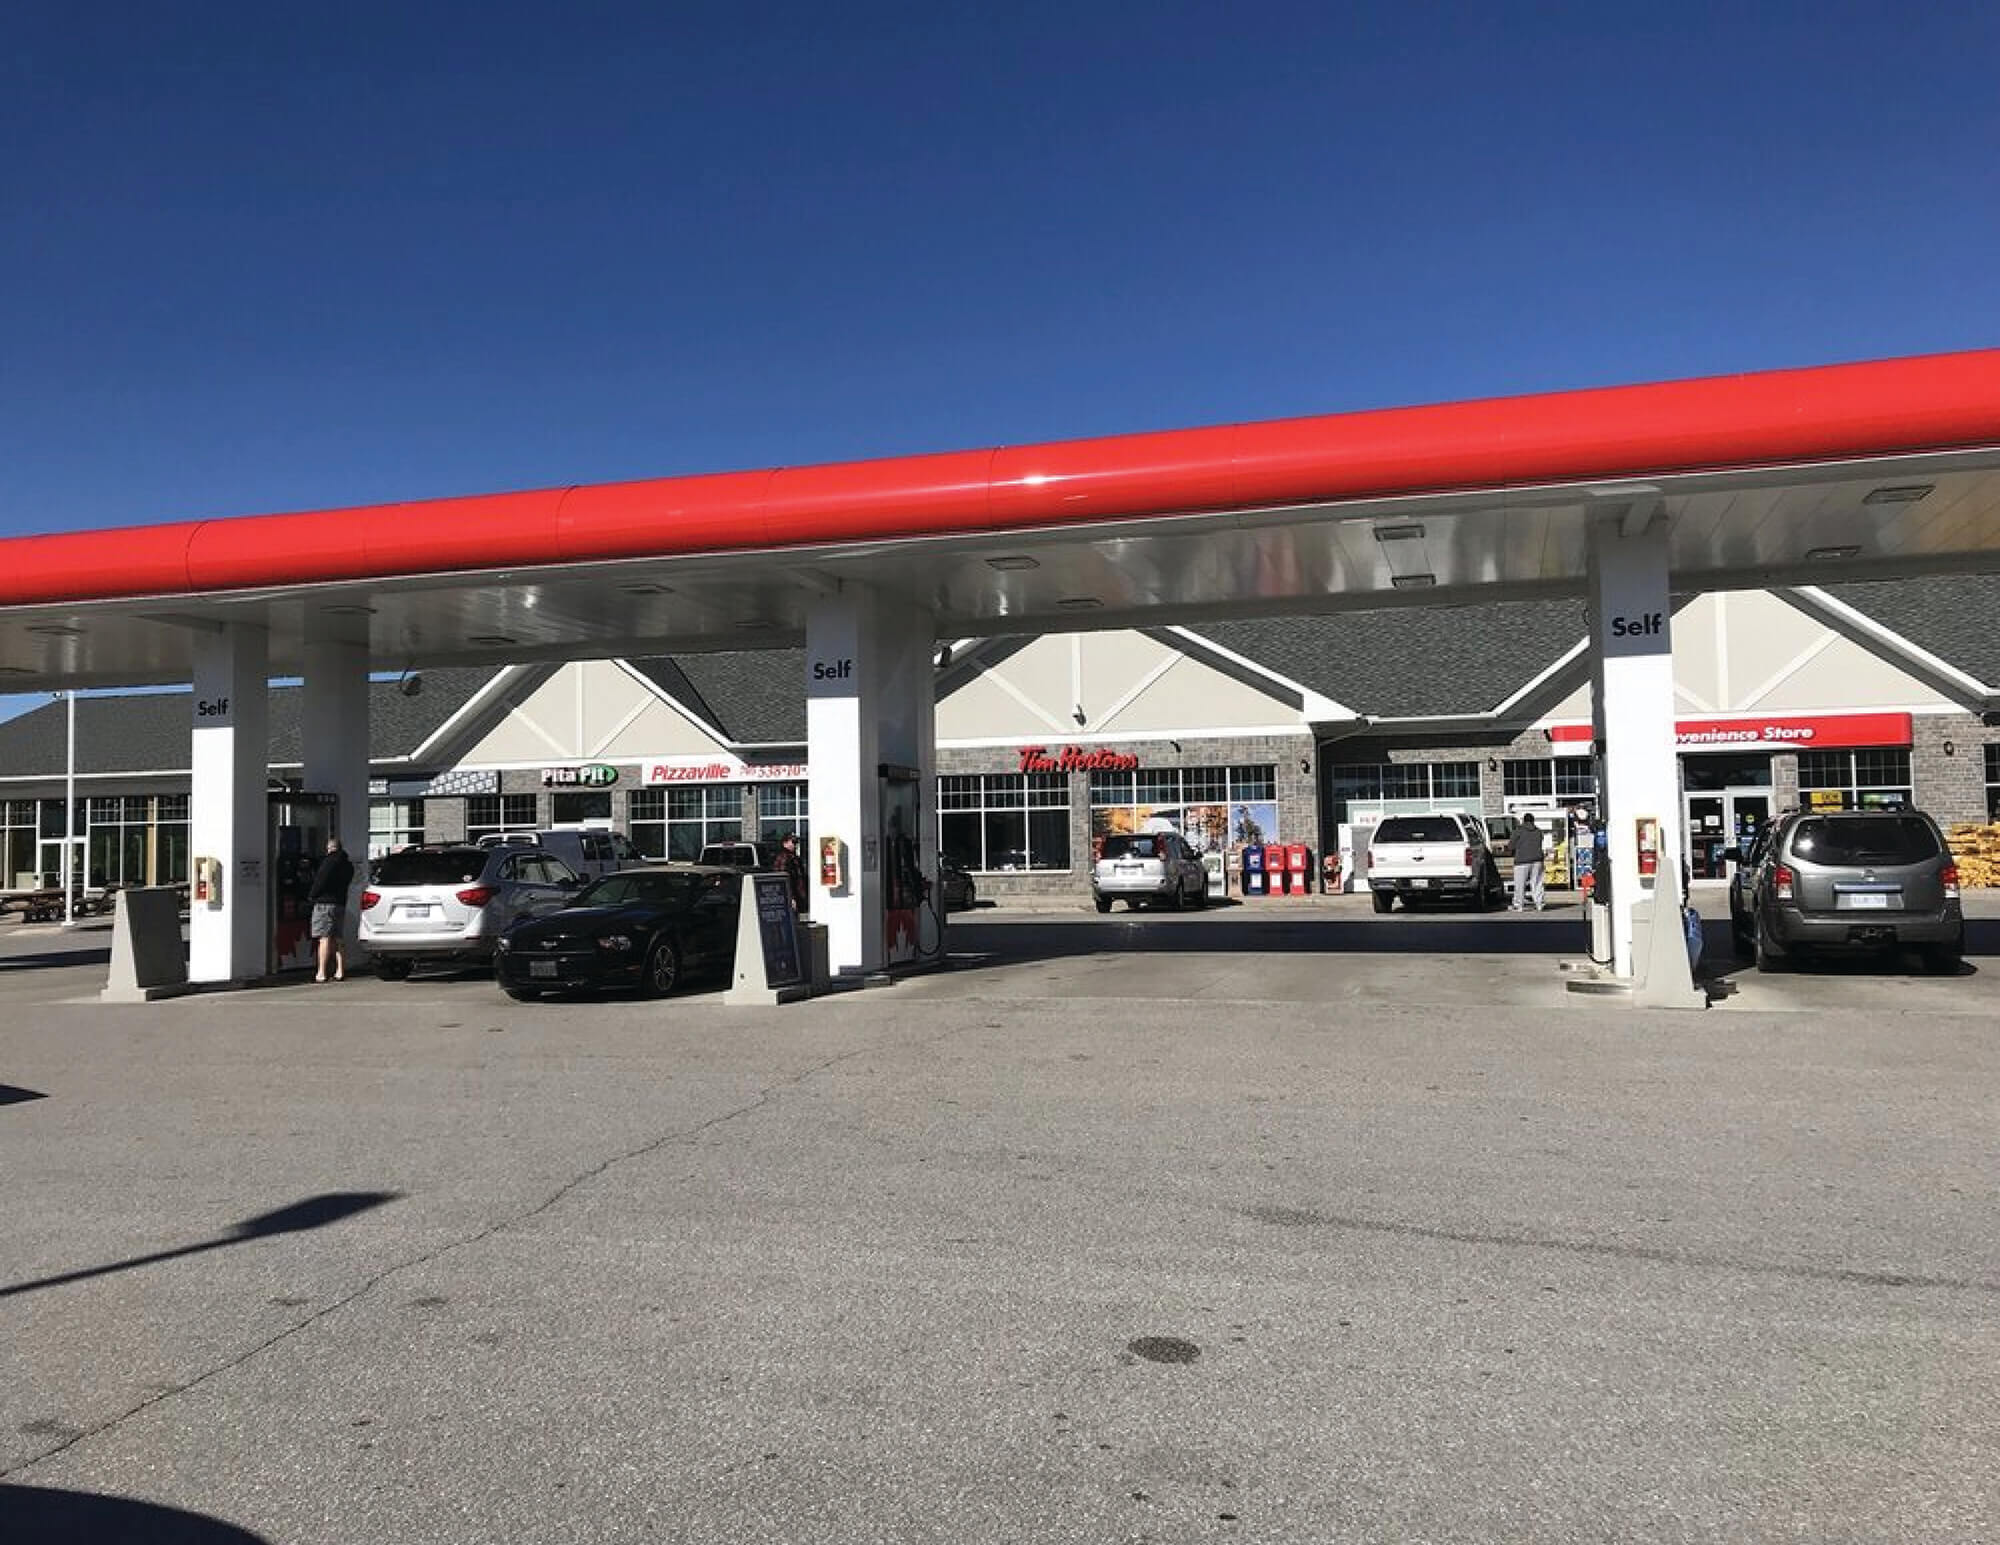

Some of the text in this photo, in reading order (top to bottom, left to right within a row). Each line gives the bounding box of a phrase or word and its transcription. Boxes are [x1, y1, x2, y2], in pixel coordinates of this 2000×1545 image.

[1611, 613, 1662, 636] Self
[813, 659, 852, 680] Self
[198, 698, 229, 716] Self
[1676, 726, 1814, 743] venience Store
[1018, 744, 1138, 773] Tim Hortons
[541, 767, 605, 784] Pita Pit
[652, 763, 731, 782] Pizzaville
